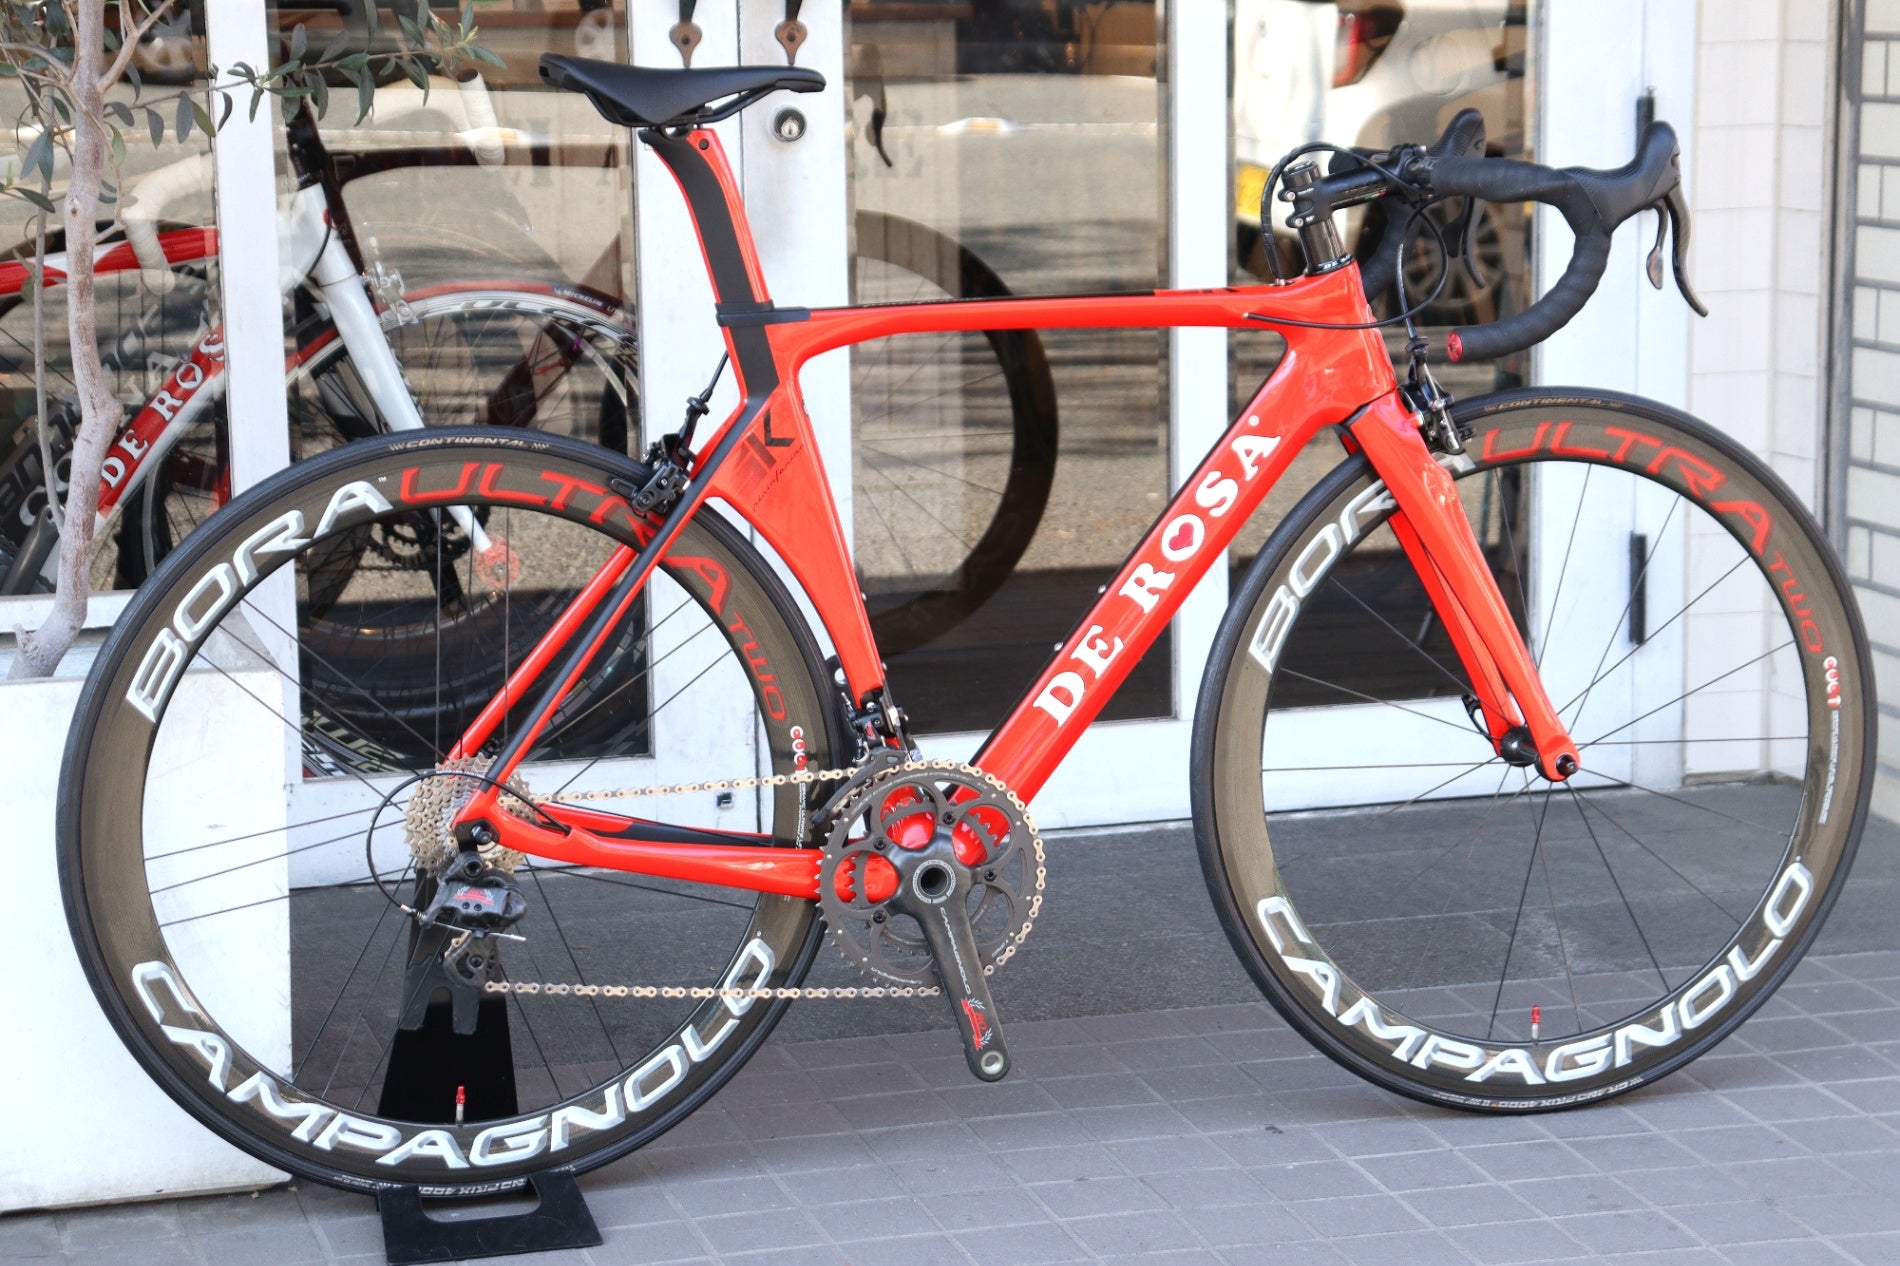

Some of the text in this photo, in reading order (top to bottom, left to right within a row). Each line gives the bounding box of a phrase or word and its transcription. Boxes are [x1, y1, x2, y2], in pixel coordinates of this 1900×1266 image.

[100, 333, 225, 489] DE ROS
[405, 436, 530, 449] CONTINENTAL
[1498, 396, 1606, 410] CONTINENTAL
[1482, 420, 1780, 559] ULTRA
[126, 480, 394, 723] BORA
[1033, 434, 1282, 728] DE ROSA
[940, 906, 972, 995] CAMPAGNOLO
[1256, 862, 1816, 1085] CAMPAGNOLO
[131, 937, 776, 1171] CAMPAGNOLO
